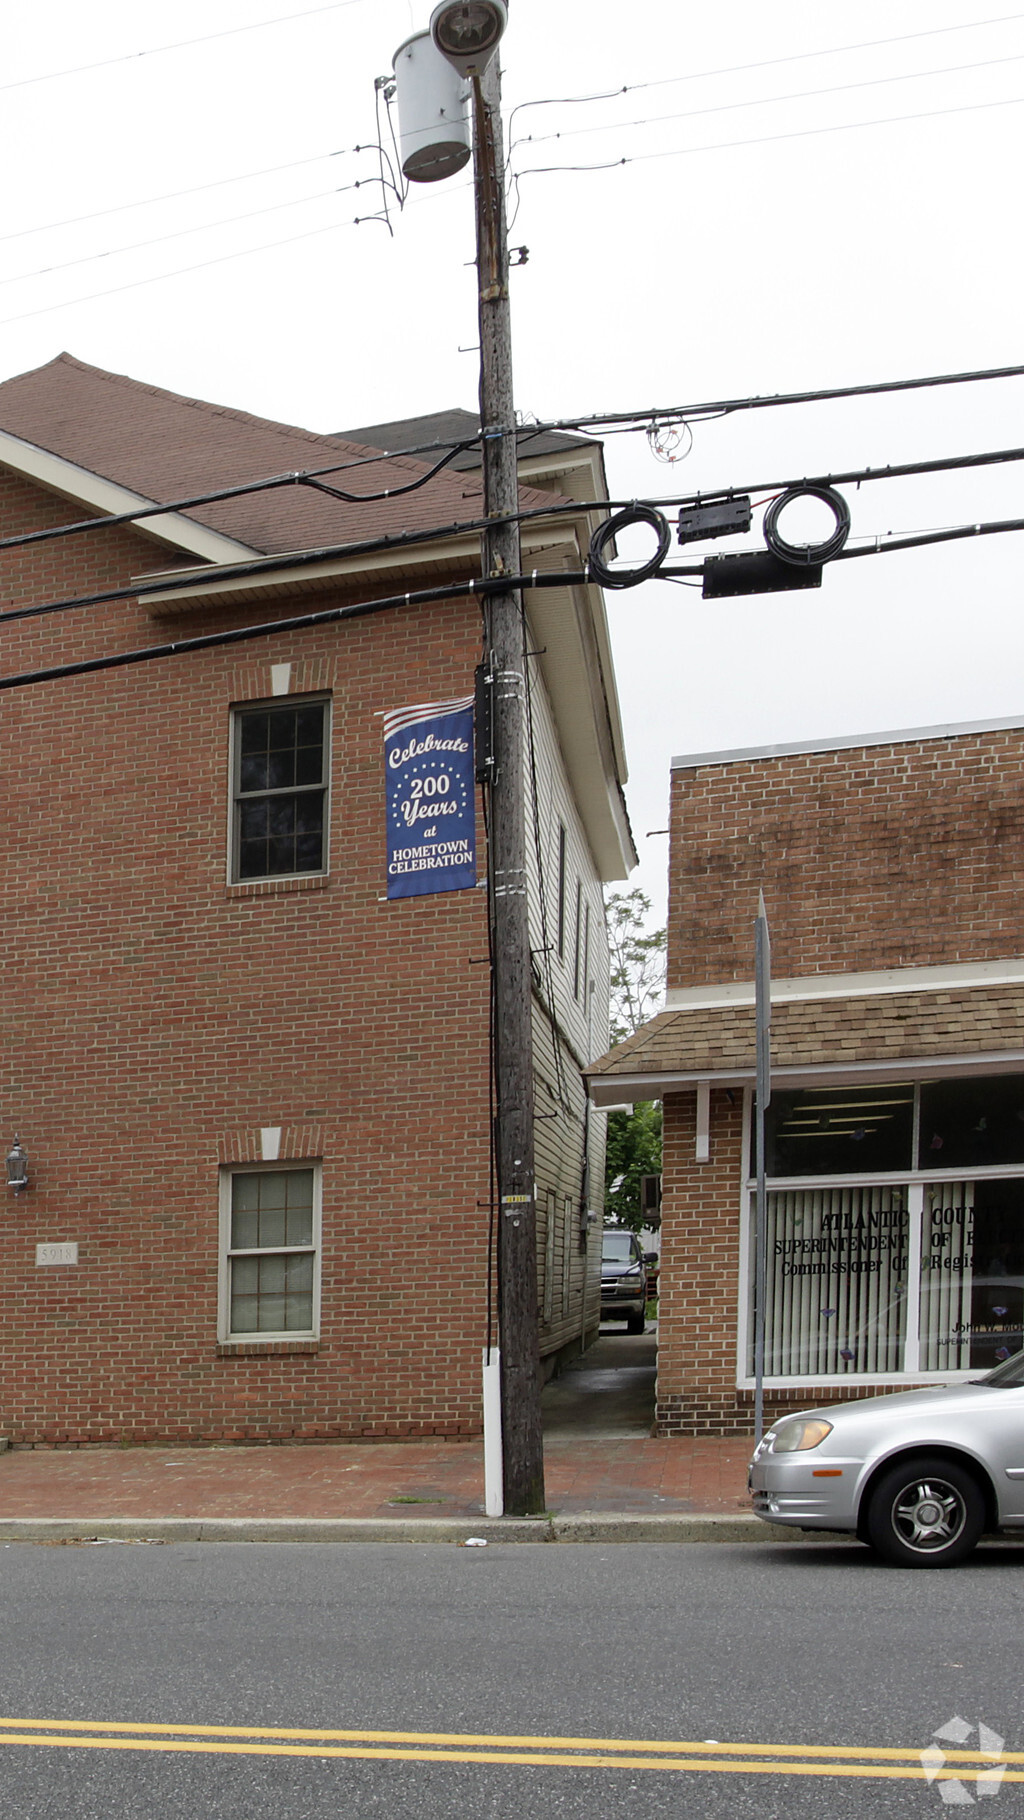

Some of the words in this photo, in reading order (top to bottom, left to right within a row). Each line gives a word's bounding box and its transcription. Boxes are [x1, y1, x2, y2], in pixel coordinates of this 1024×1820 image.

[388, 734, 469, 769] Celebrate
[410, 774, 450, 799] 200
[400, 798, 458, 827] Years
[423, 825, 437, 838] at
[392, 839, 469, 861] HOMETOWN
[388, 851, 473, 875] CELEBRATION
[821, 1210, 909, 1231] ATLANTIC
[775, 1234, 908, 1254] SUPERINTENDENT
[931, 1232, 952, 1248] OF
[40, 1248, 72, 1262] 5918
[892, 1255, 908, 1271] Of
